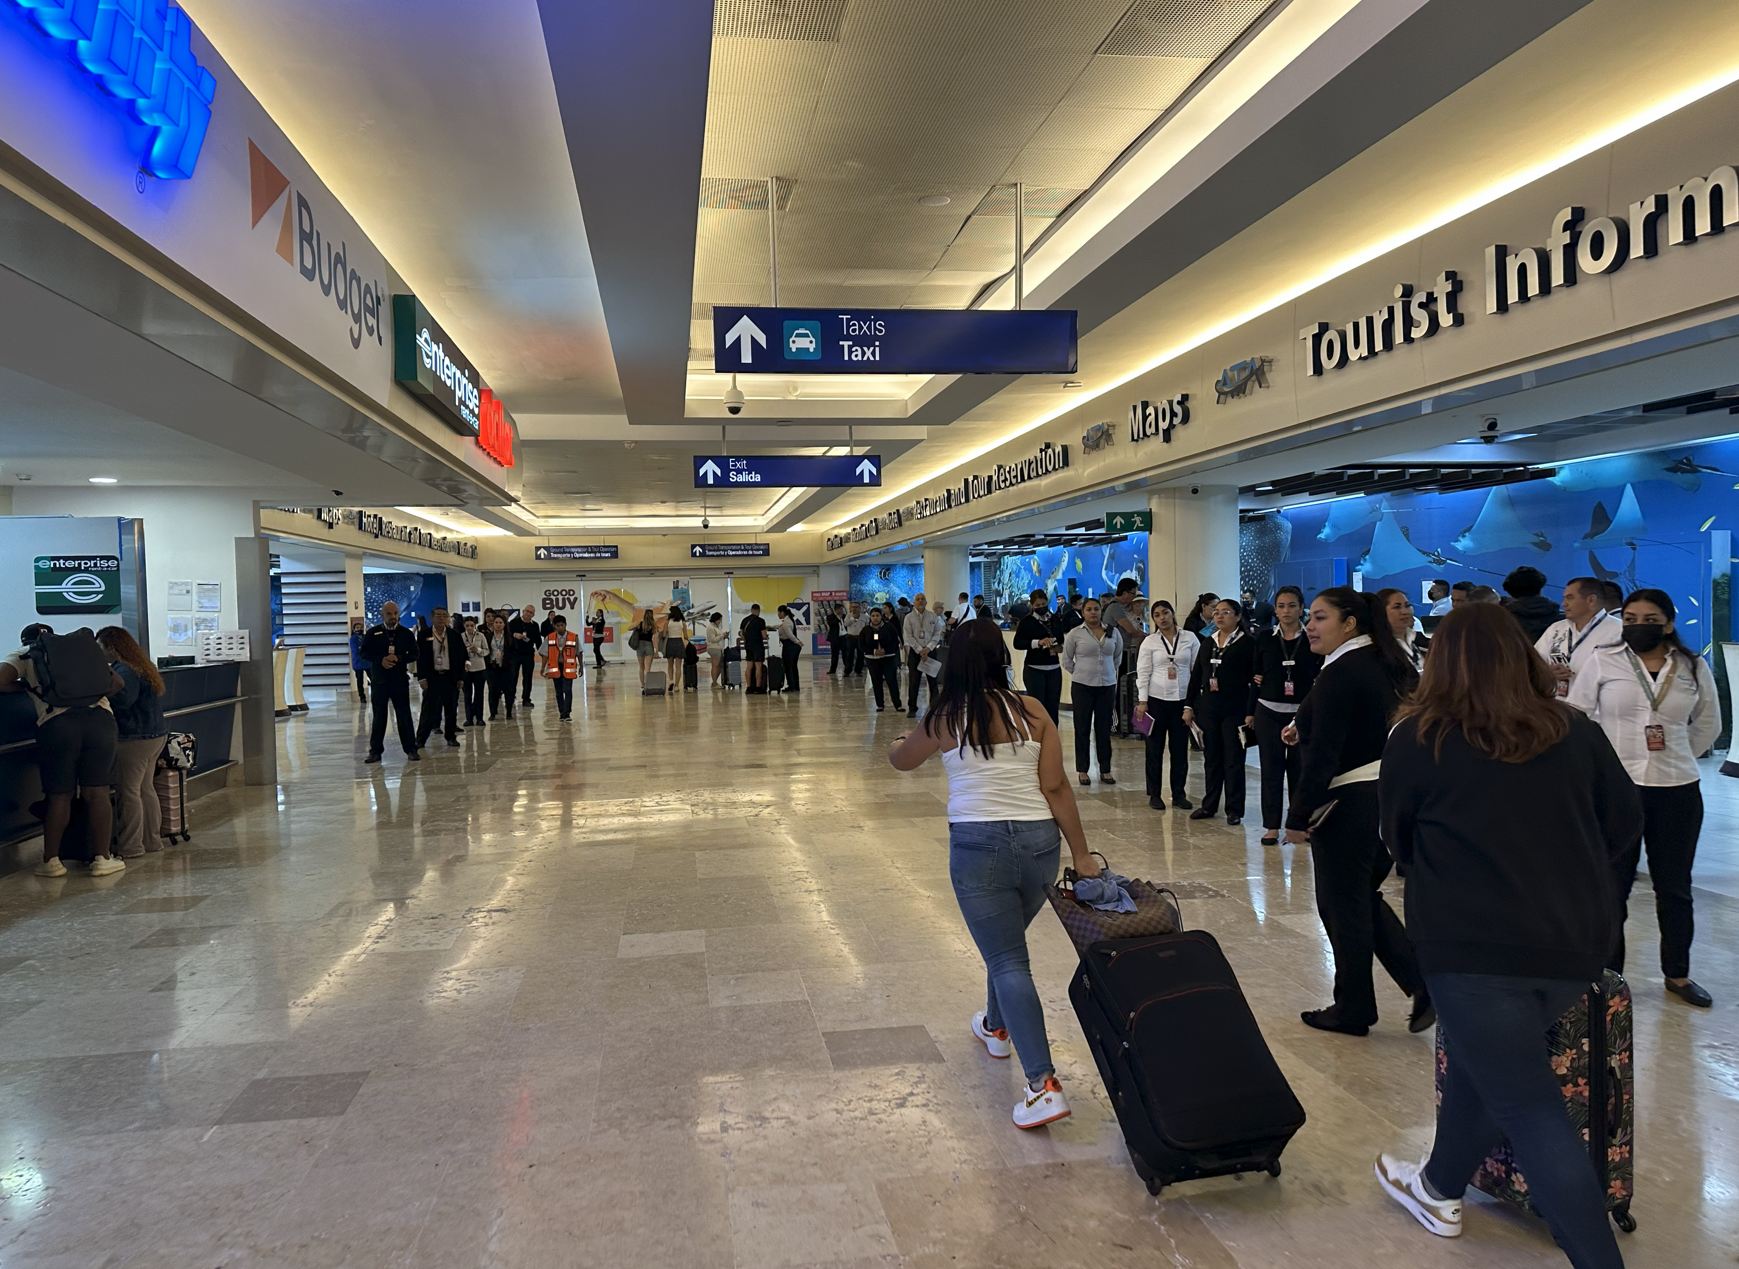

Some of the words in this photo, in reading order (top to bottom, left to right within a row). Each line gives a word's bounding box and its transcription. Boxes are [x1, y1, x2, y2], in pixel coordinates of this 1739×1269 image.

[297, 190, 382, 350] Budget
[839, 314, 886, 336] Taxis
[1300, 270, 1465, 377] Tourist
[839, 340, 881, 361] Taxi
[417, 328, 480, 415] enterprise
[1128, 393, 1190, 443] Maps
[729, 458, 747, 470] Exit
[729, 471, 761, 482] Salida
[950, 477, 969, 508] and
[967, 474, 992, 499] Tour
[992, 442, 1069, 490] Reservation
[36, 557, 118, 570] enterprise
[542, 597, 578, 610] BUY
[544, 589, 576, 597] GOOD
